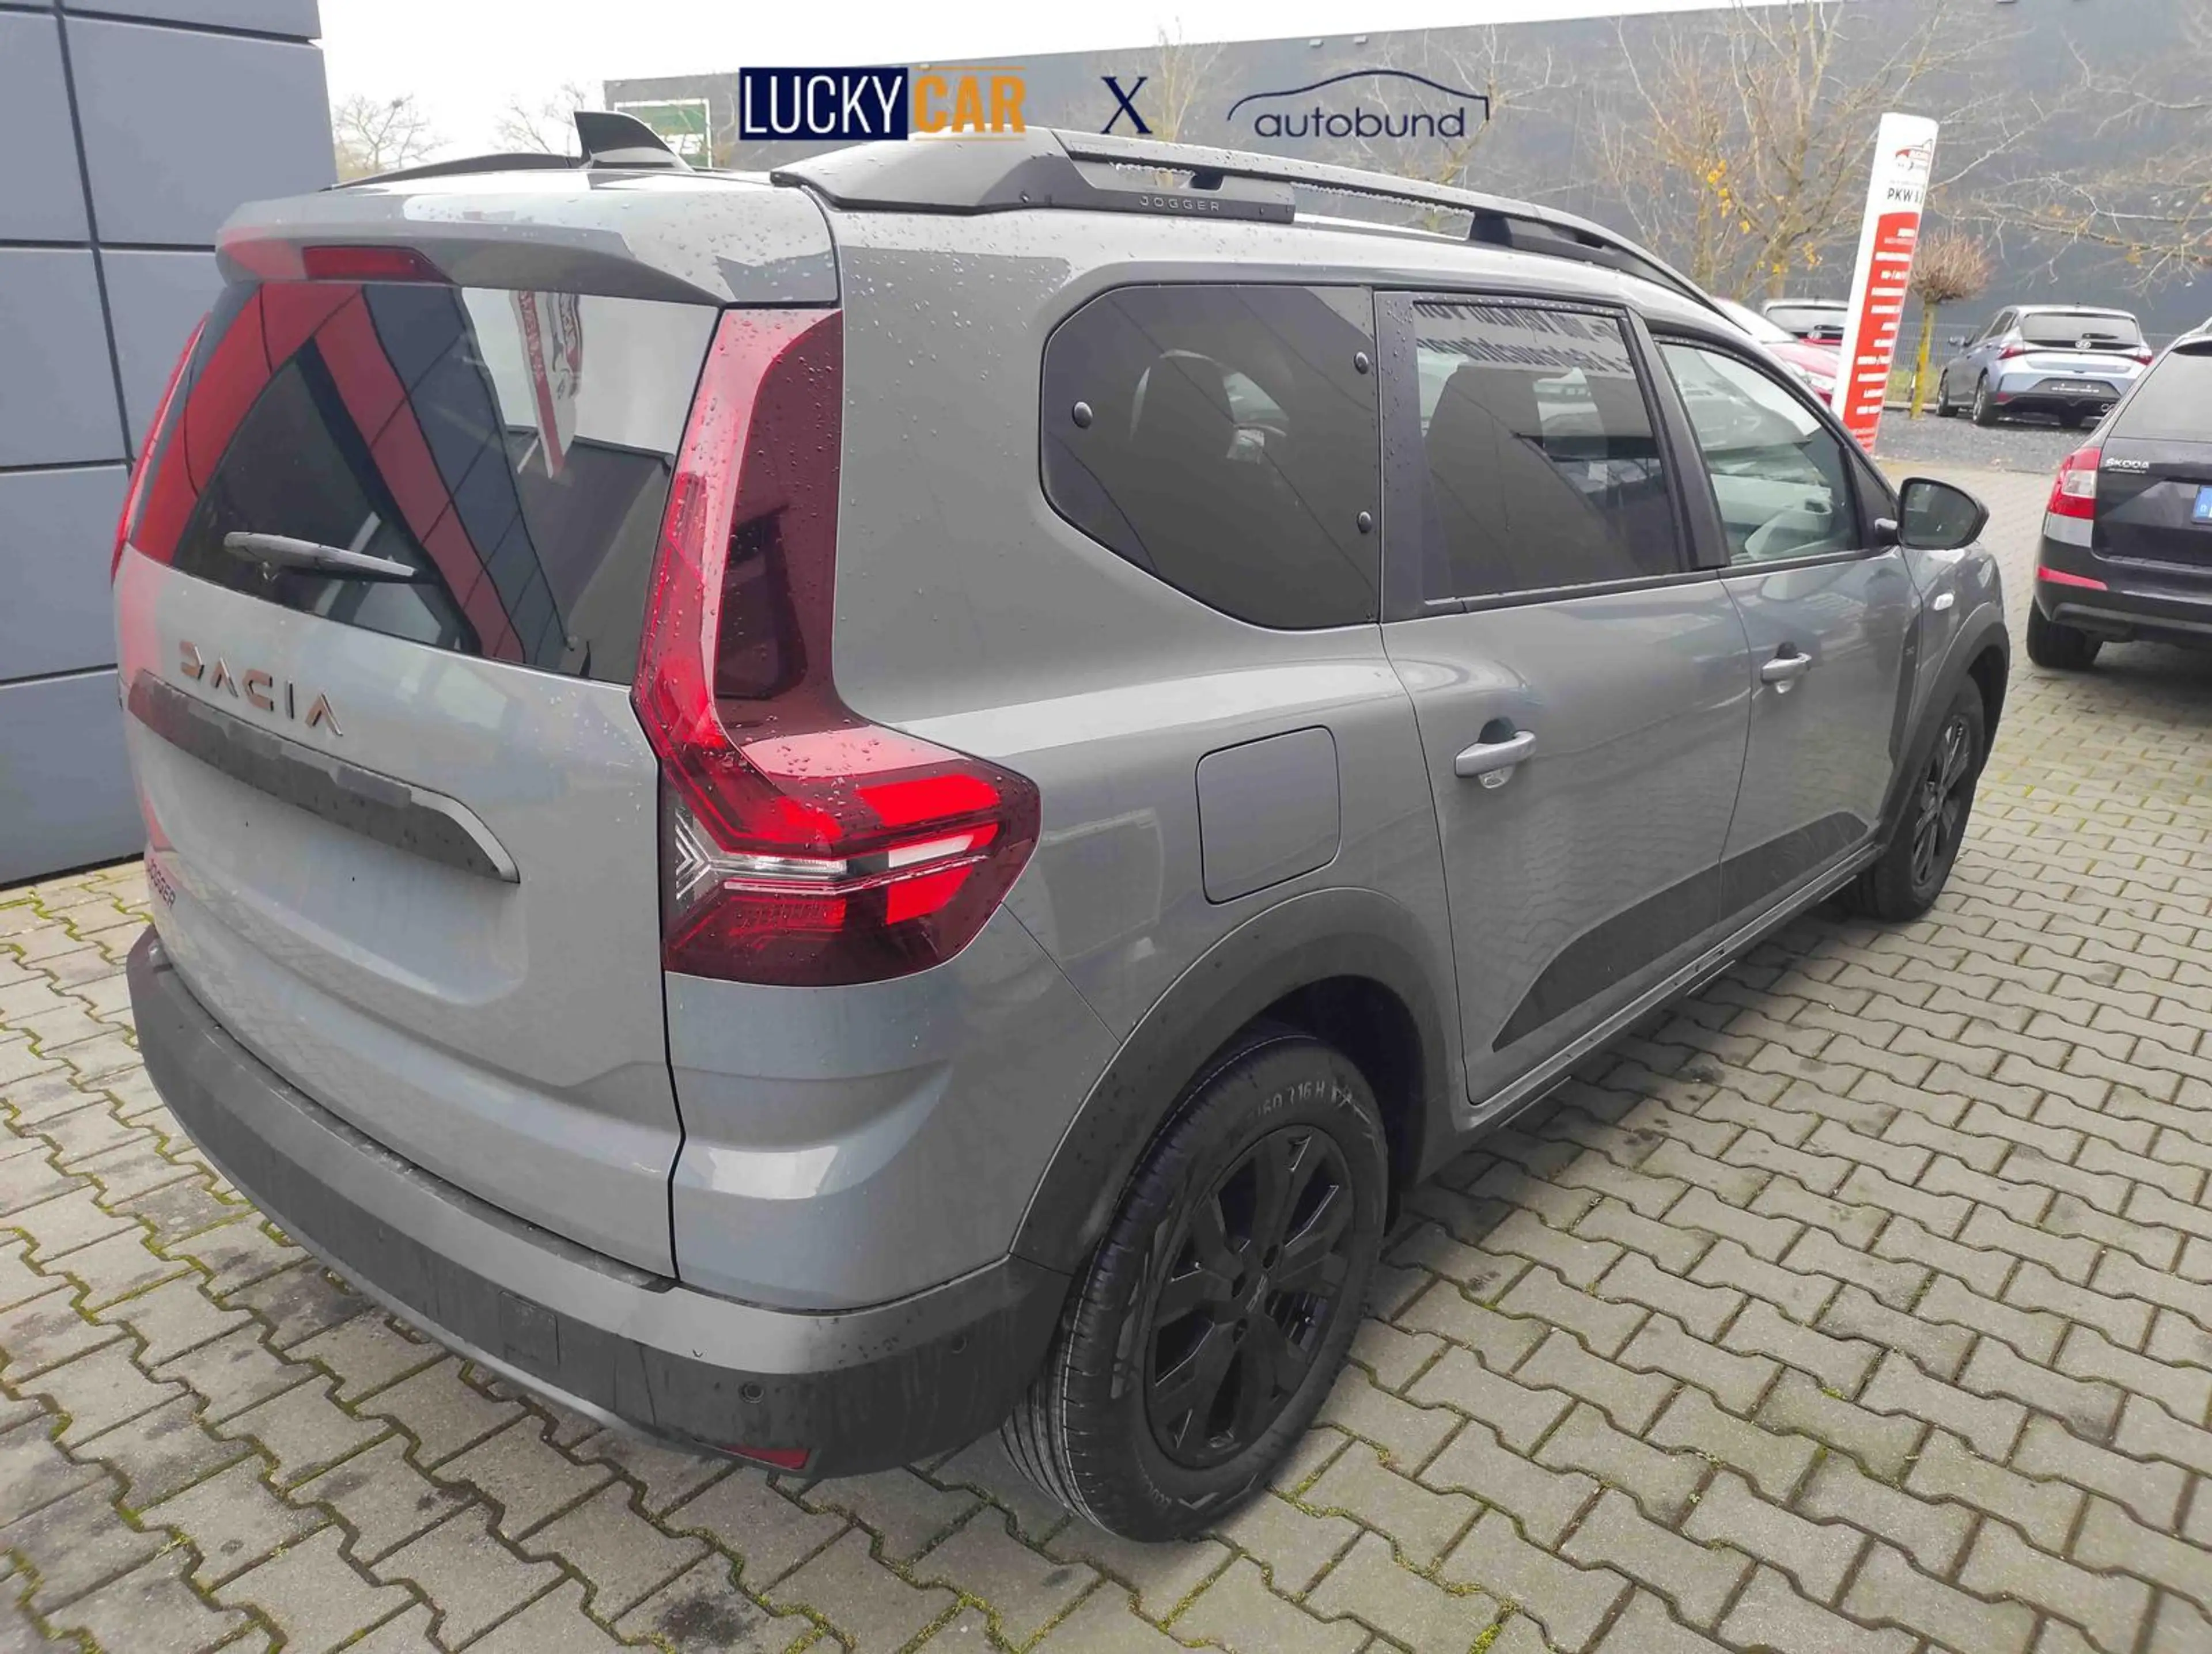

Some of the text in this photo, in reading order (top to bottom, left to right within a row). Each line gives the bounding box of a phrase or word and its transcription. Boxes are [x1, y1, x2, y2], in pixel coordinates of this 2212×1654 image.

[1887, 187, 1914, 203] PKW
[1140, 196, 1219, 211] JOGGER
[179, 640, 344, 737] DACIA
